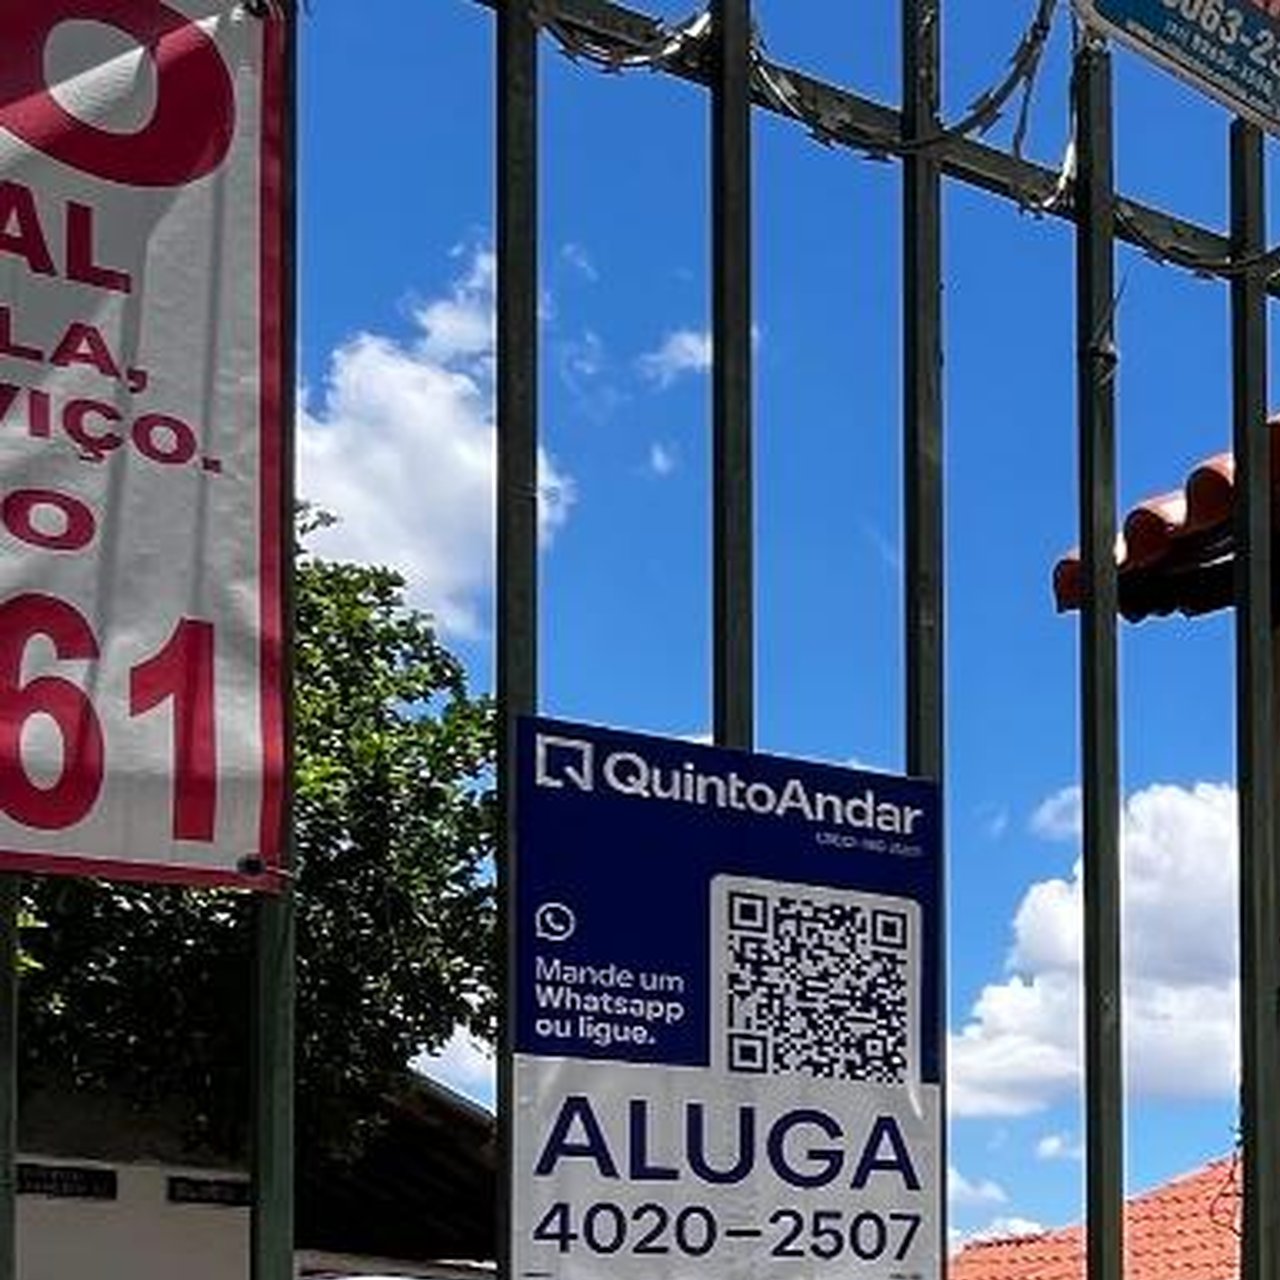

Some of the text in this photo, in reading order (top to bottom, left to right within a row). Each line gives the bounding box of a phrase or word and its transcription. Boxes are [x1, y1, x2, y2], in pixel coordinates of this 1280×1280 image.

[0, 592, 215, 843] 61
[603, 751, 925, 835] QuintoAndar
[534, 956, 685, 994] Mande um
[534, 985, 685, 1024] Whatsapp
[534, 1016, 656, 1047] ou ligue.
[533, 1096, 922, 1192] ALUGA
[532, 1202, 922, 1261] 4020-2507
